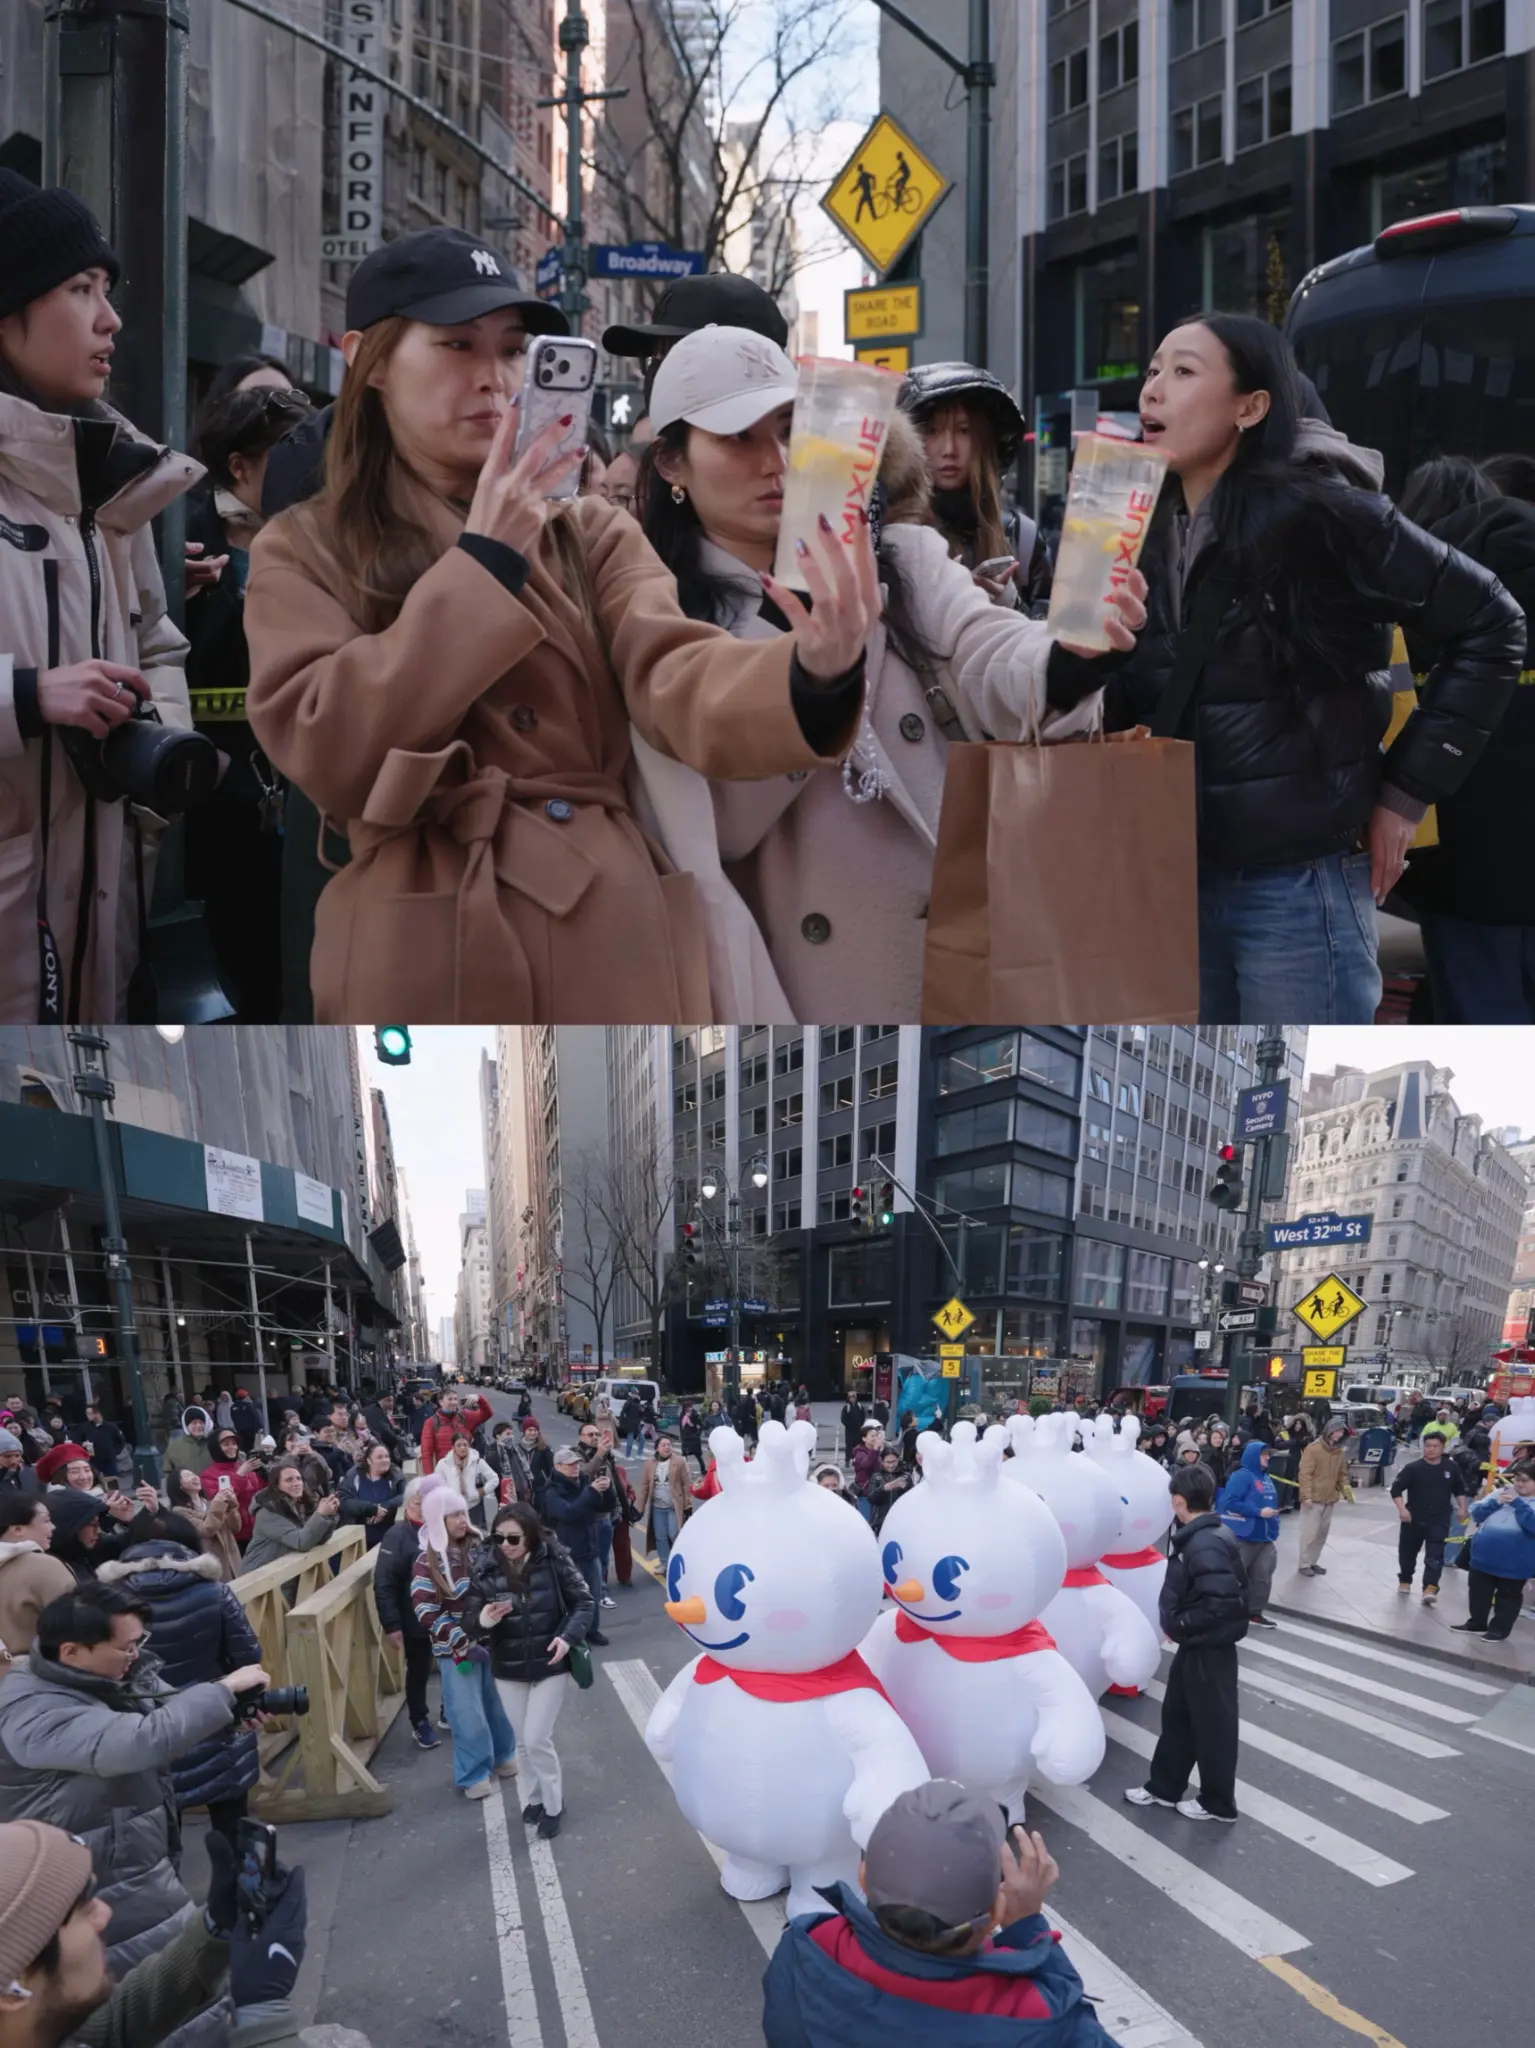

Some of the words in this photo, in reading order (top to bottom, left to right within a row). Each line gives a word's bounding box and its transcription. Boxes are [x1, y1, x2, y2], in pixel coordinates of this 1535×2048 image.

[348, 4, 374, 231] STANFORD
[322, 241, 370, 256] OTEL
[608, 252, 693, 280] Broadway
[853, 298, 888, 314] SHARE
[893, 295, 912, 309] THE
[866, 314, 898, 329] ROAD
[841, 416, 885, 544] MIXUE
[1103, 490, 1153, 604] MIXUE
[1252, 1091, 1274, 1102] NYPD
[1245, 1113, 1276, 1126] Security
[1245, 1122, 1274, 1132] Camera
[1274, 1228, 1309, 1243] West
[1312, 1223, 1342, 1240] 32nd
[1345, 1222, 1362, 1237] St
[948, 1361, 955, 1371] 5
[1315, 1374, 1326, 1387] 5
